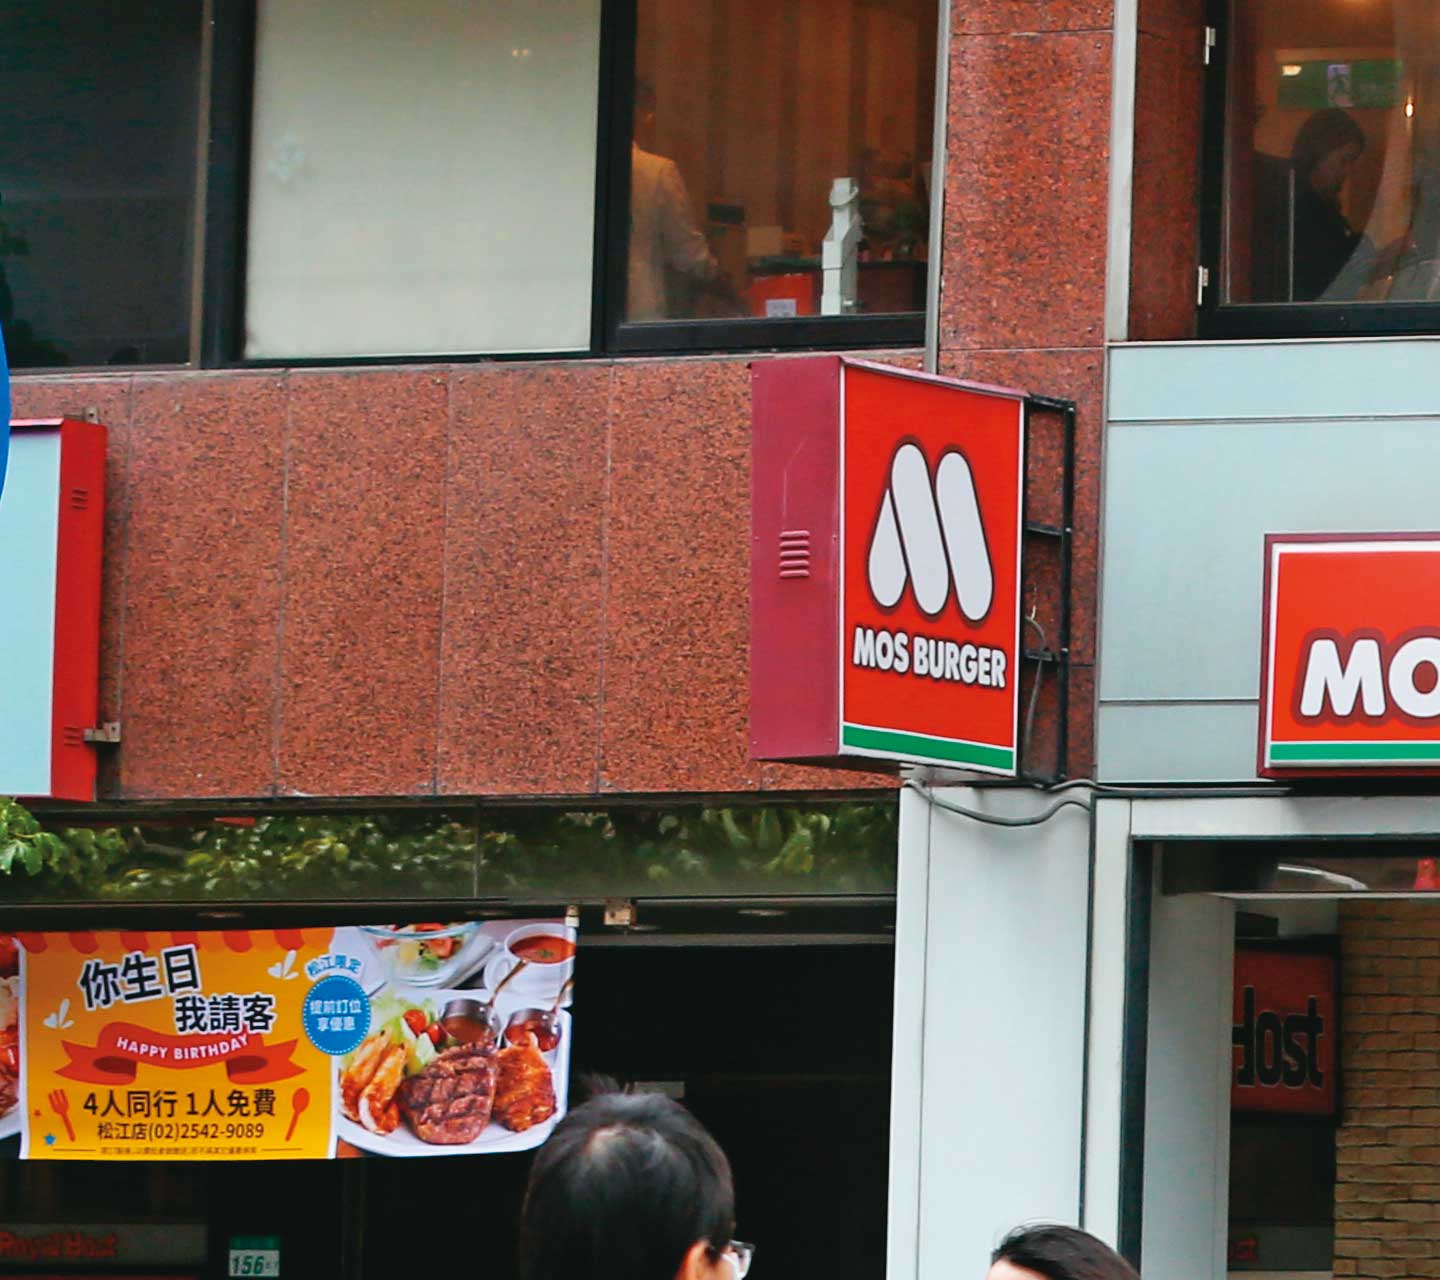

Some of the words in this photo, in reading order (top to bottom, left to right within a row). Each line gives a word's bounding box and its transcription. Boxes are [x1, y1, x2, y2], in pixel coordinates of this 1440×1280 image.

[852, 626, 910, 676] MOS
[912, 637, 1007, 689] BURGER
[79, 947, 201, 1009] 你生日
[175, 995, 275, 1033] 我請客
[117, 1036, 168, 1059] HAPPY
[174, 1034, 249, 1060] BIRTHDAY
[83, 1089, 177, 1118] 4人同行
[186, 1089, 276, 1117] 1人免費
[97, 1122, 264, 1141] 松江店(02)2542-9089
